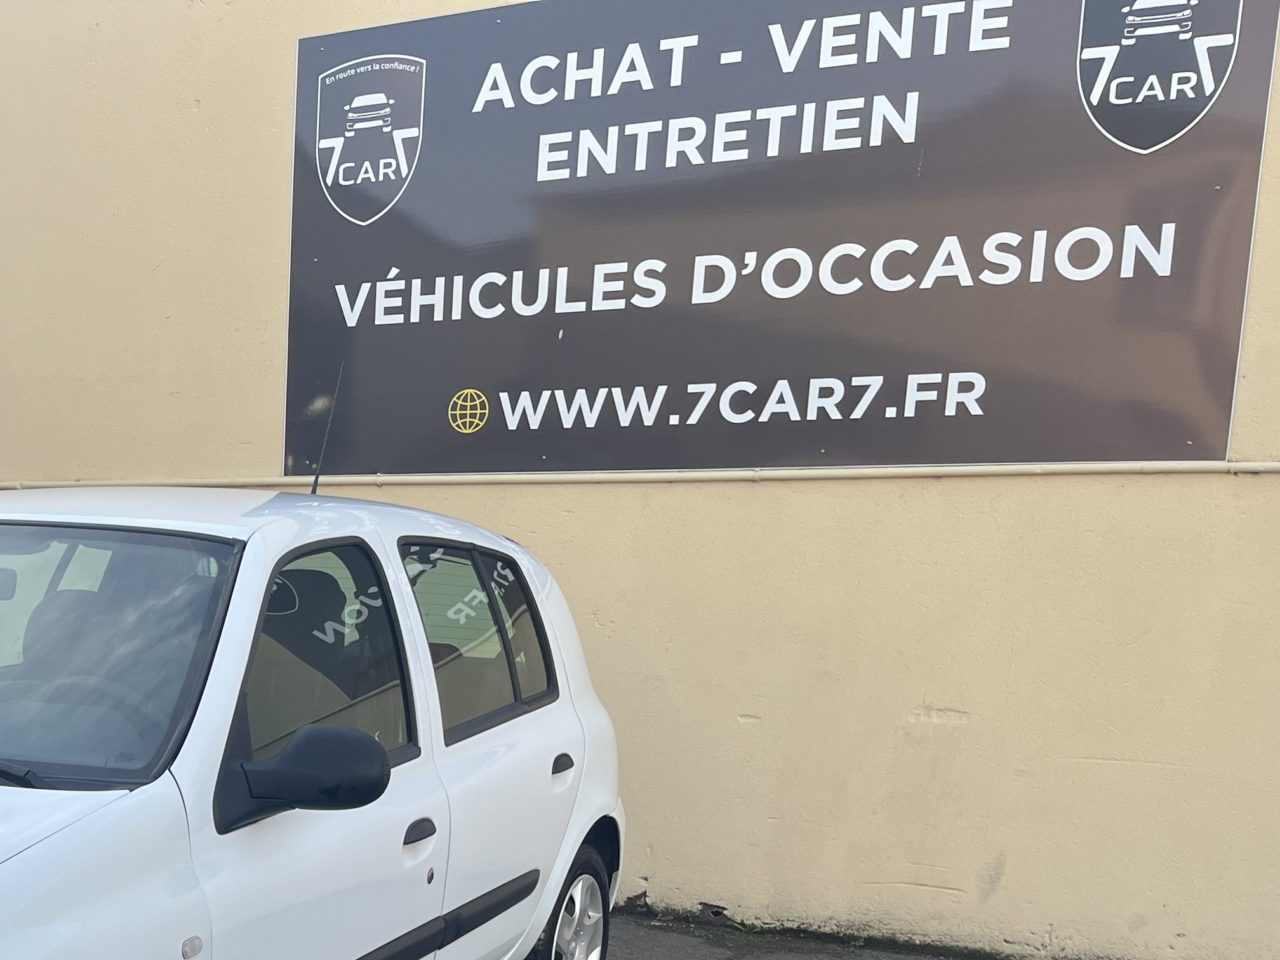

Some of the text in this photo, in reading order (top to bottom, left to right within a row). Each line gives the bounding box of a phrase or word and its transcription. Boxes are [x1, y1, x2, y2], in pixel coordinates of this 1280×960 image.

[325, 76, 335, 85] En
[336, 68, 356, 80] route
[357, 64, 372, 73] vers
[381, 62, 415, 73] confiance
[472, 0, 1014, 113] ACHAT - VENTE
[536, 91, 920, 182] ENTRETIEN
[334, 222, 1176, 328] VÉHICULES D'OCCASION
[498, 371, 987, 431] WWW.7CAR7.FR
